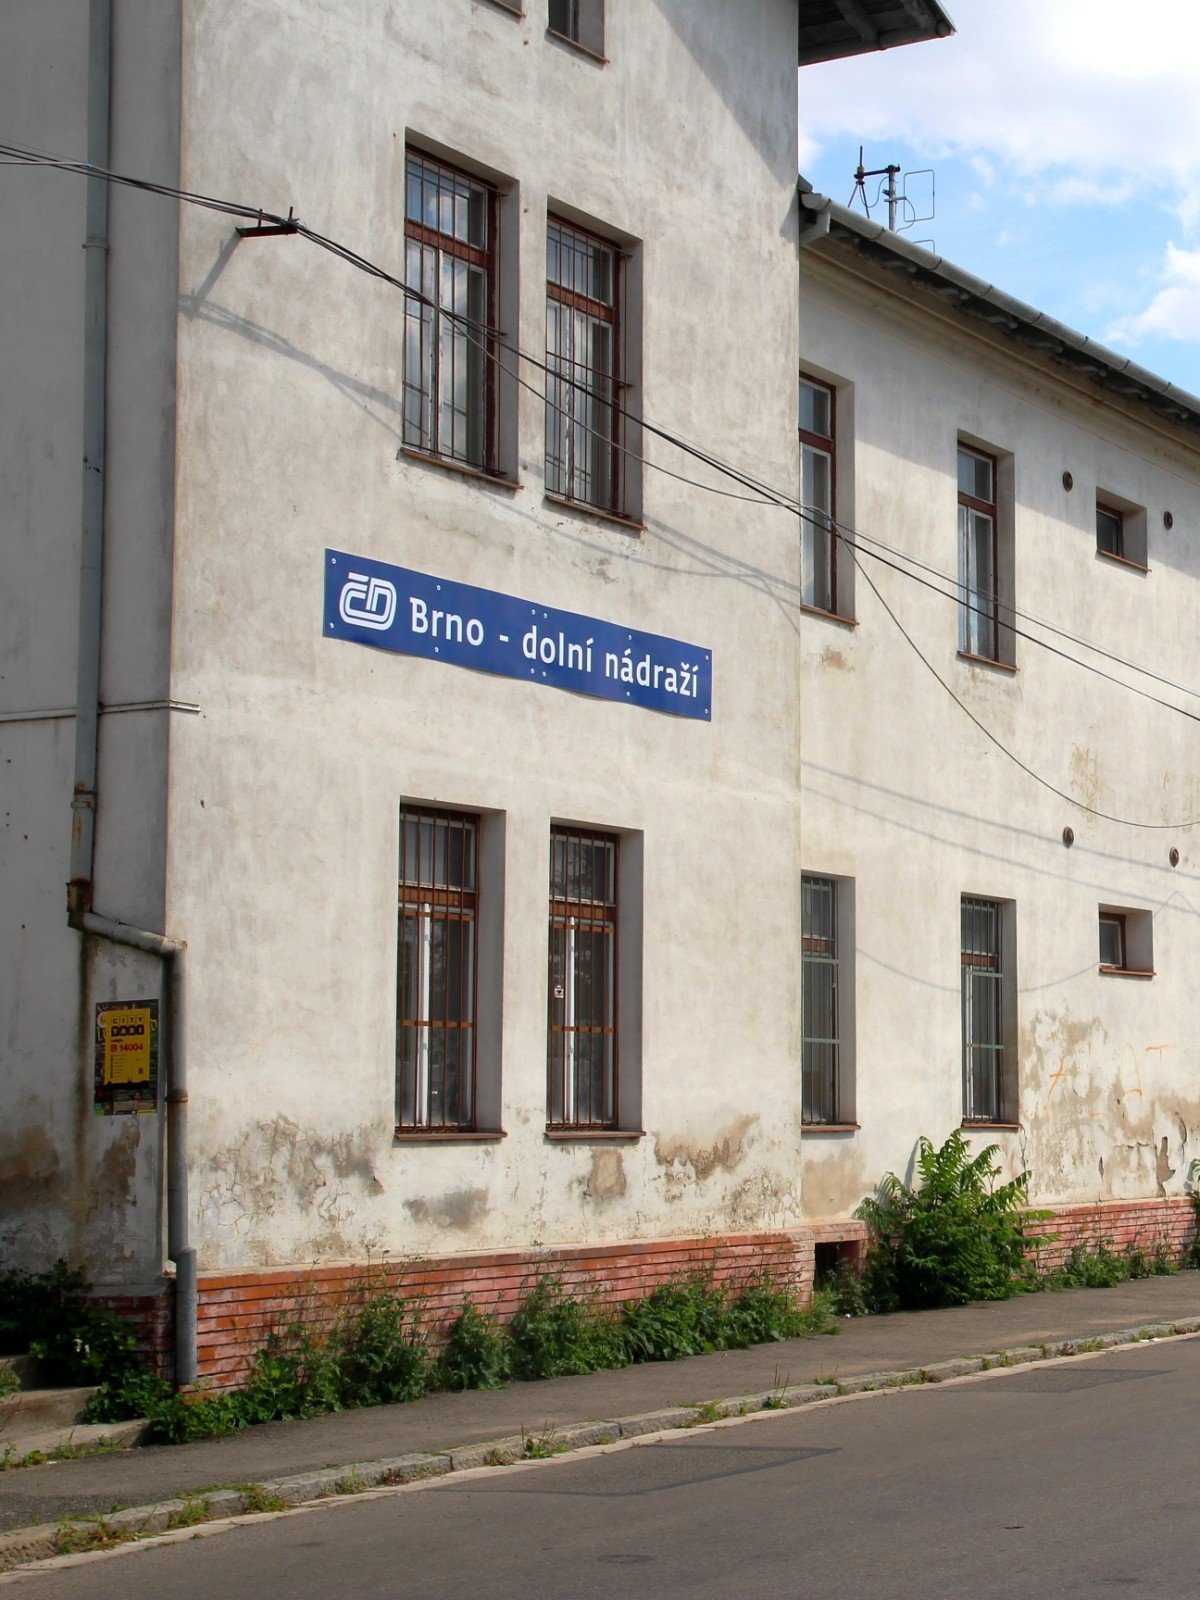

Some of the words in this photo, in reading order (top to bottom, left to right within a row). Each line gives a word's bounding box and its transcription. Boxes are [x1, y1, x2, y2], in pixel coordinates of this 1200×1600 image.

[409, 596, 484, 647] Brno
[522, 625, 594, 673] dolní
[605, 648, 699, 698] nádraží
[112, 1016, 143, 1024] CITY
[112, 1026, 143, 1035] TAXI
